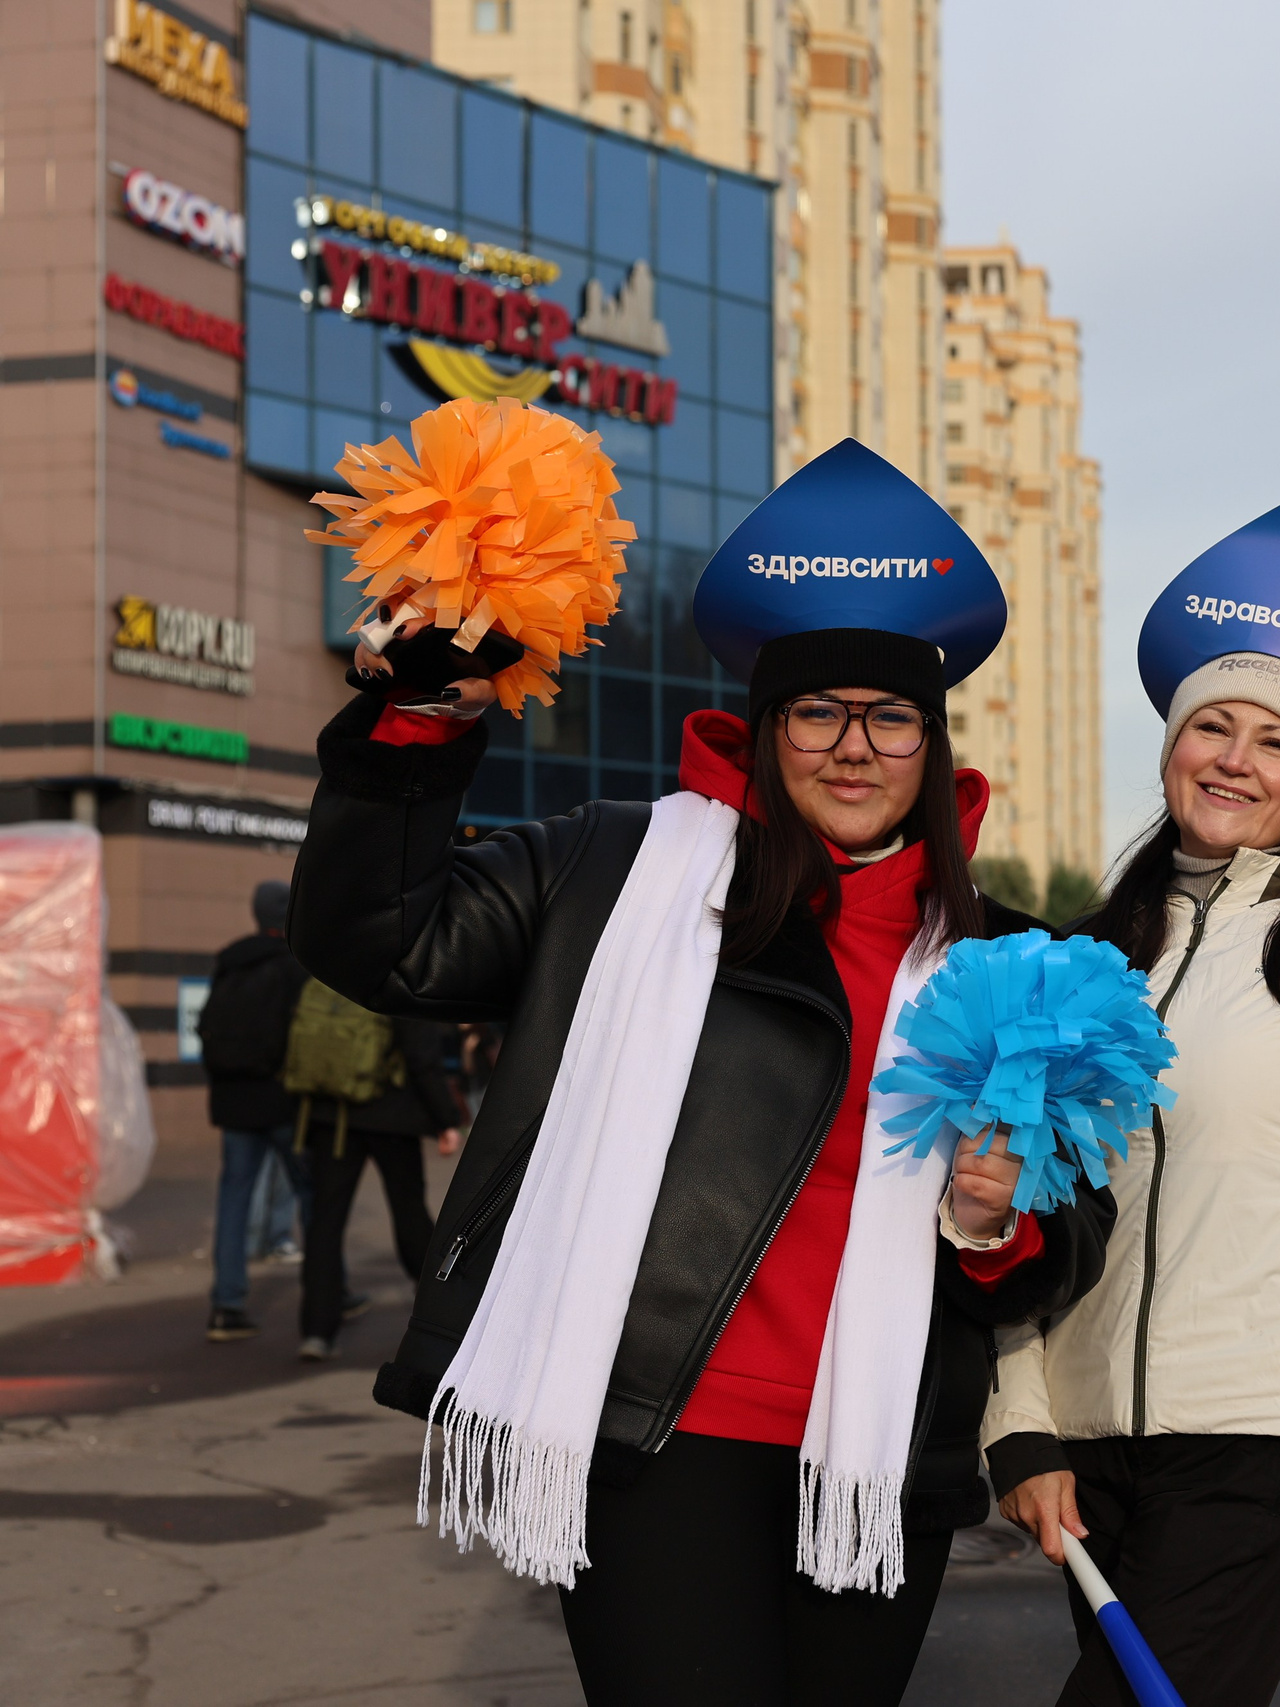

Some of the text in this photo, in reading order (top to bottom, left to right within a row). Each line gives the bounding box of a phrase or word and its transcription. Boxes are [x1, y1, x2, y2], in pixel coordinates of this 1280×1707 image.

[126, 170, 245, 259] OZON
[321, 239, 573, 363] УНИВЕР
[556, 353, 679, 426] СИТИ
[747, 553, 928, 584] здравсити
